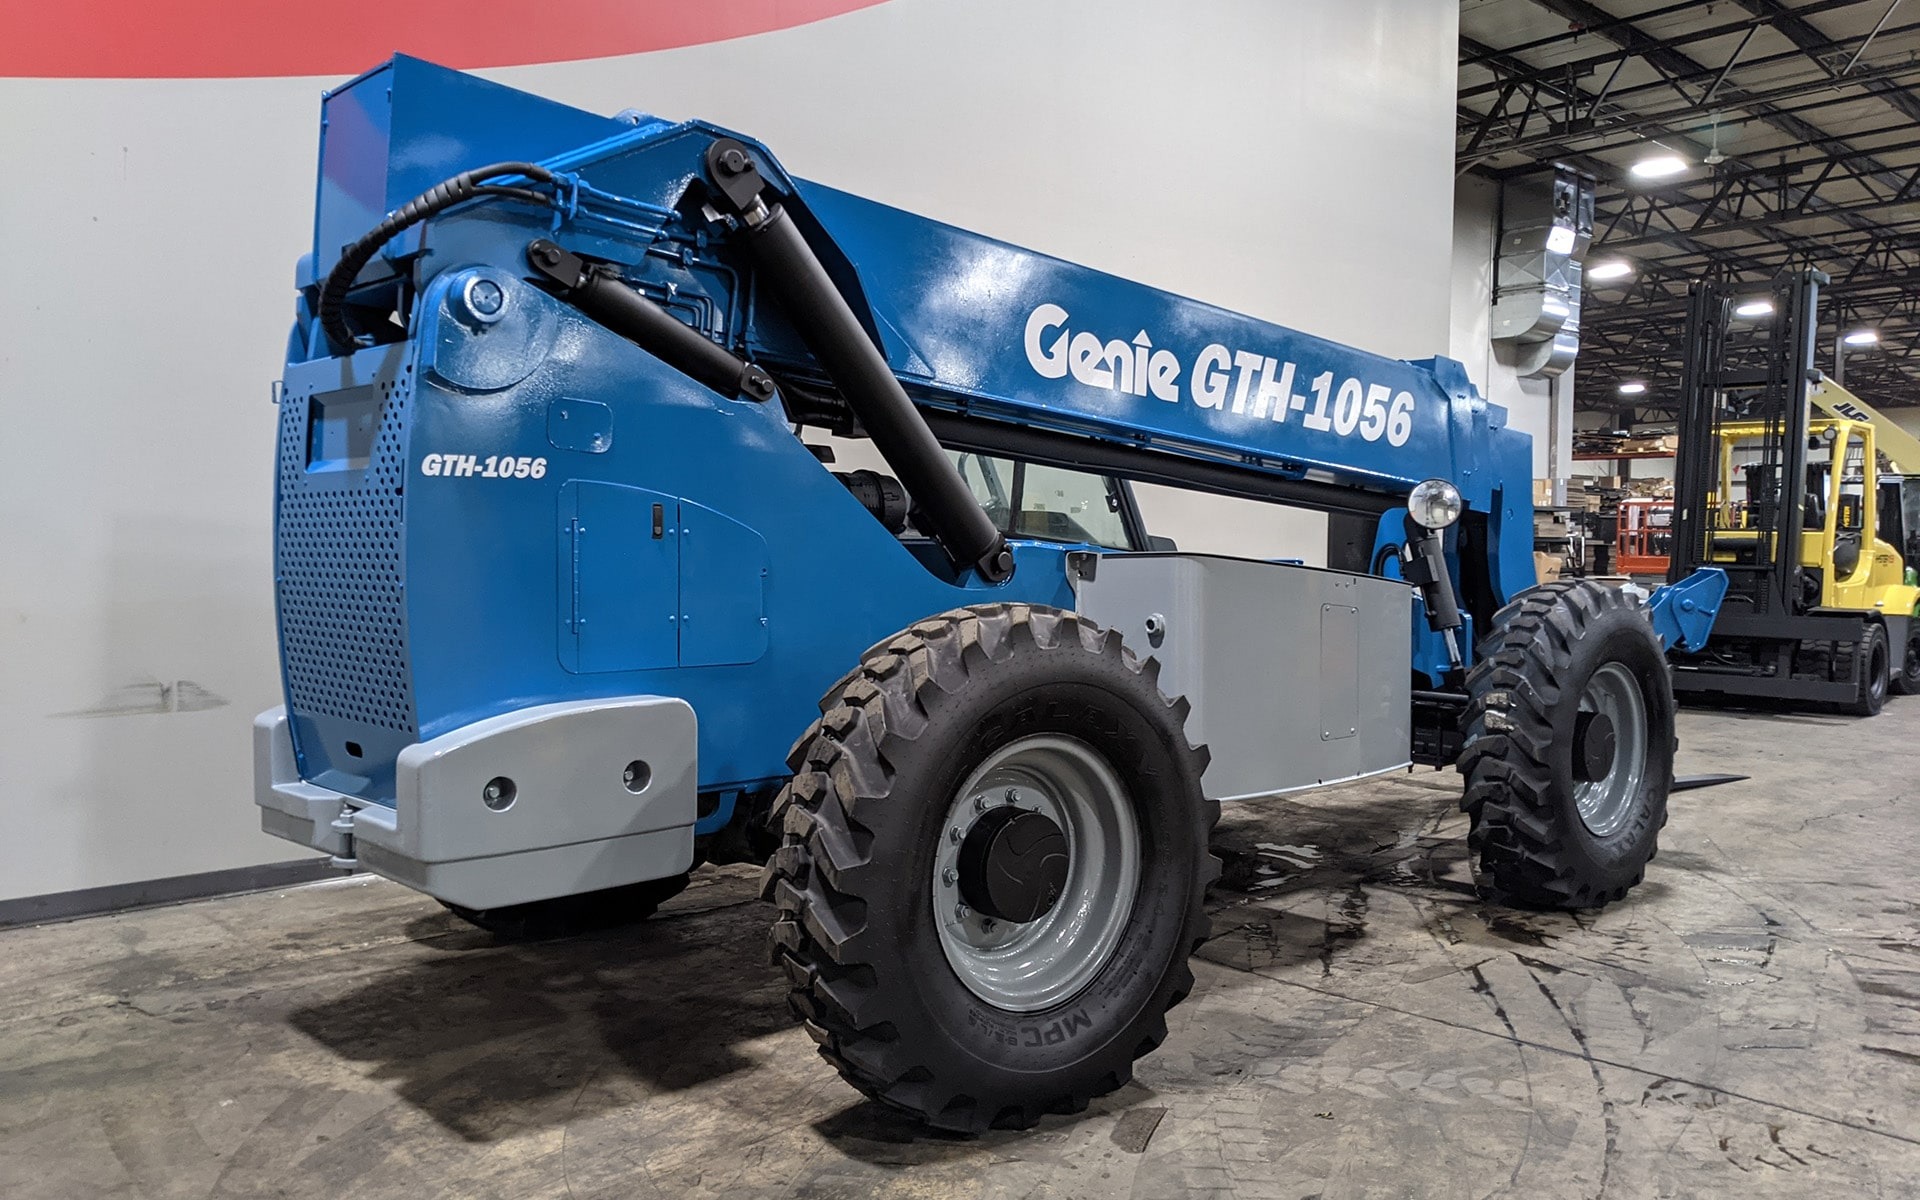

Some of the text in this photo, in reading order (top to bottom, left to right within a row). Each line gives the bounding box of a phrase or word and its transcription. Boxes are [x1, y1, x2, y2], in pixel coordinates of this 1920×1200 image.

[1024, 303, 1415, 447] Genie GTH-1056
[421, 453, 547, 479] GTH-1056
[1021, 1008, 1093, 1047] MPC
